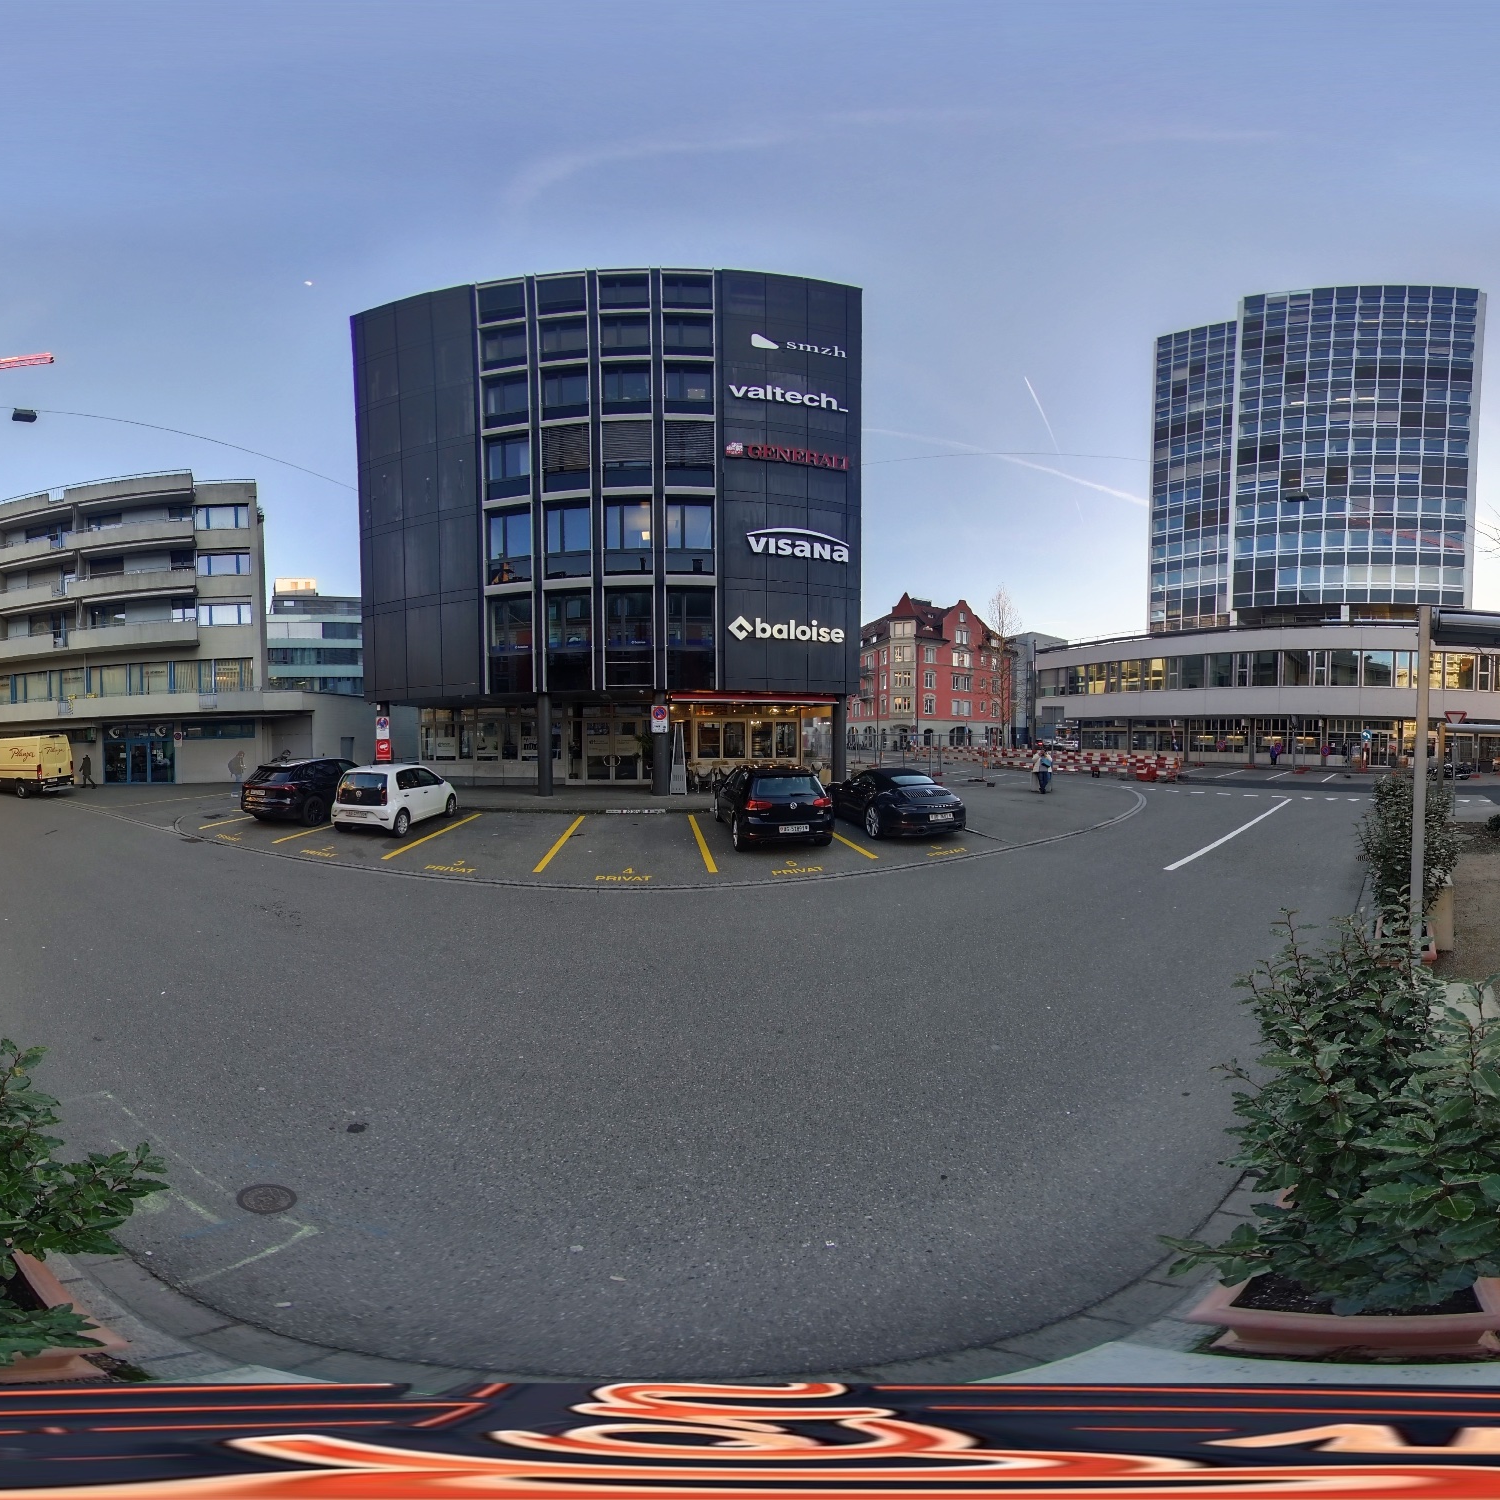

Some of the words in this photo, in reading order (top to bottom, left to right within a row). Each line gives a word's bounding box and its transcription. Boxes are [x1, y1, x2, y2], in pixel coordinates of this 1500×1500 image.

[786, 341, 847, 358] smzh
[747, 444, 849, 470] GENERALI
[755, 617, 845, 643] baloise
[300, 848, 339, 858] PRIVAT
[424, 864, 477, 874] PRIVAT
[771, 866, 824, 876] PRIVAT
